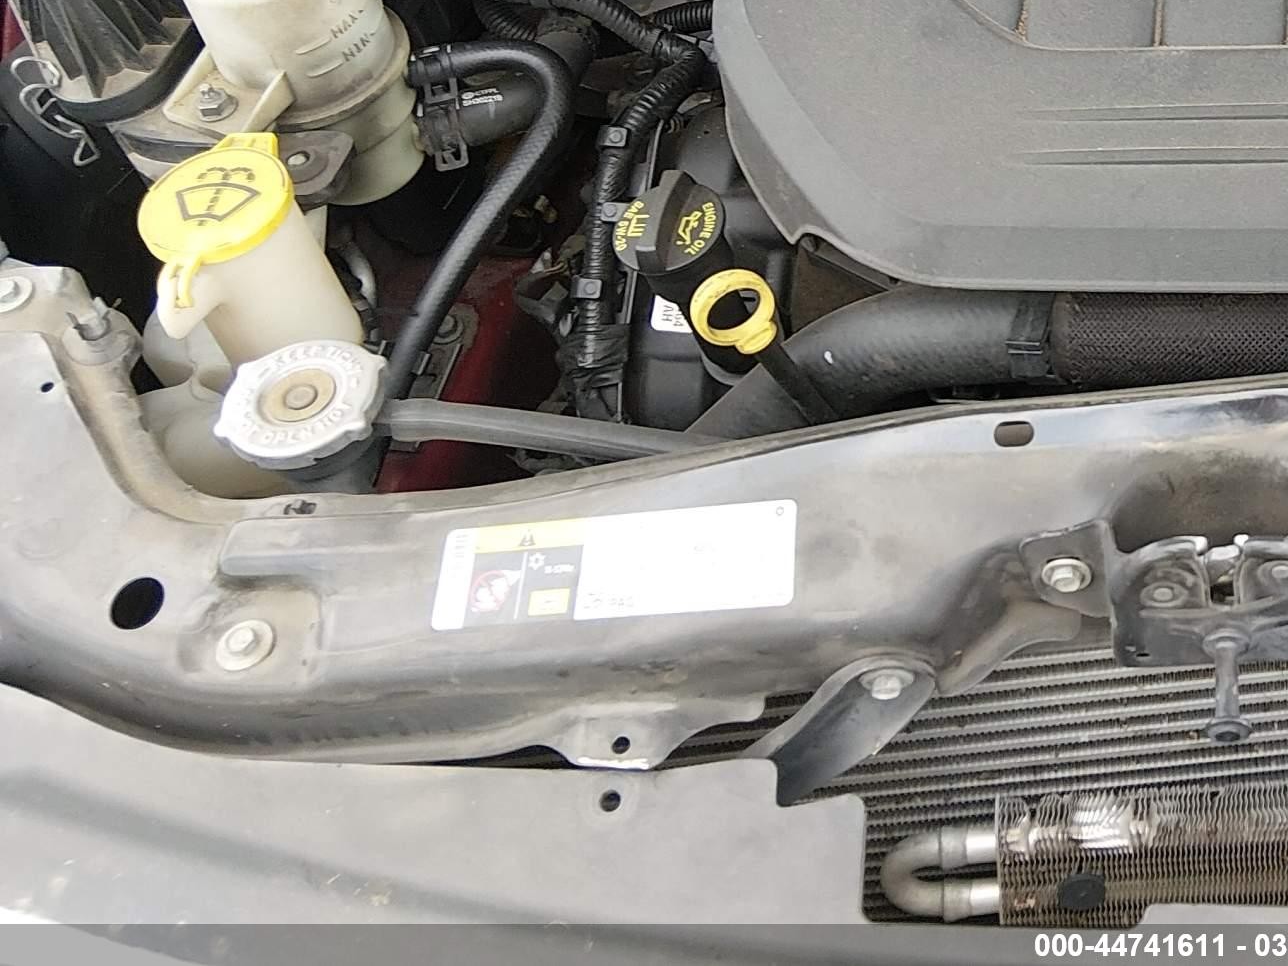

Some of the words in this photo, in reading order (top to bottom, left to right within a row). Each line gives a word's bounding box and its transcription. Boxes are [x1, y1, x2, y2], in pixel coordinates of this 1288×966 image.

[624, 200, 645, 219] SAE
[699, 201, 717, 239] ENGINE
[683, 239, 706, 256] OIL
